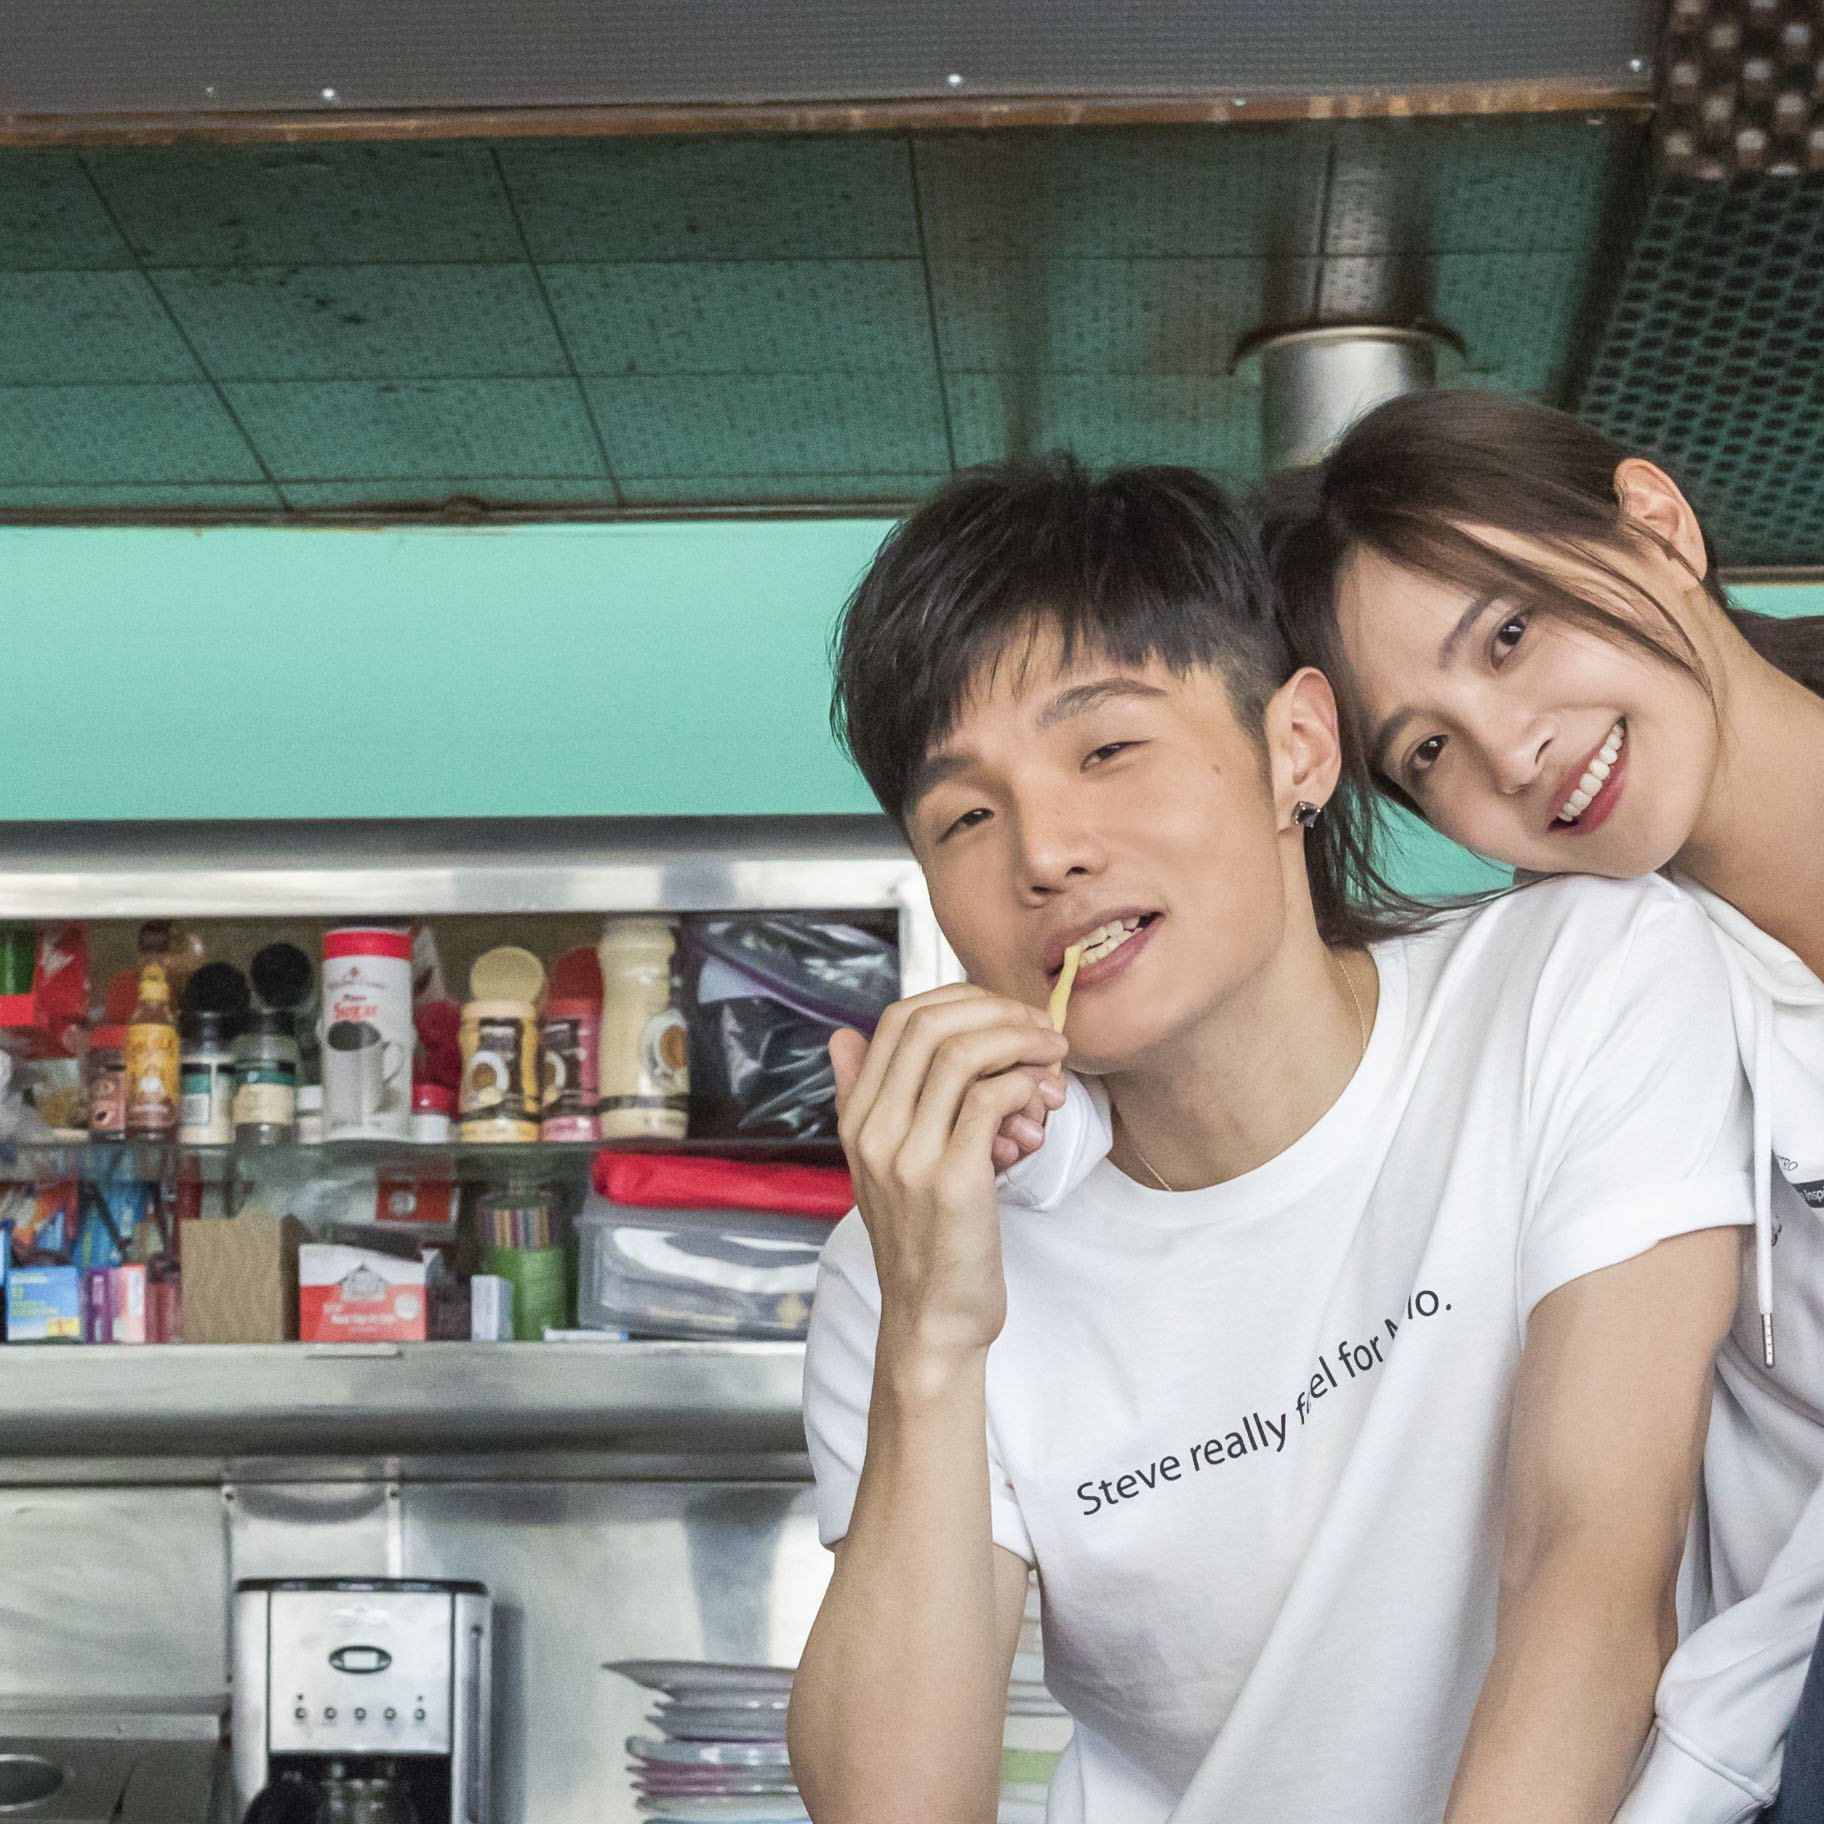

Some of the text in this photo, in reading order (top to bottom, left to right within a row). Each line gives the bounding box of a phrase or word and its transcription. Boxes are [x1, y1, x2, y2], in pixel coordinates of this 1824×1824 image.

[1077, 1456, 1182, 1516] Steve
[1189, 1411, 1288, 1472] really
[1296, 1356, 1338, 1425] fel
[1338, 1335, 1384, 1379] for
